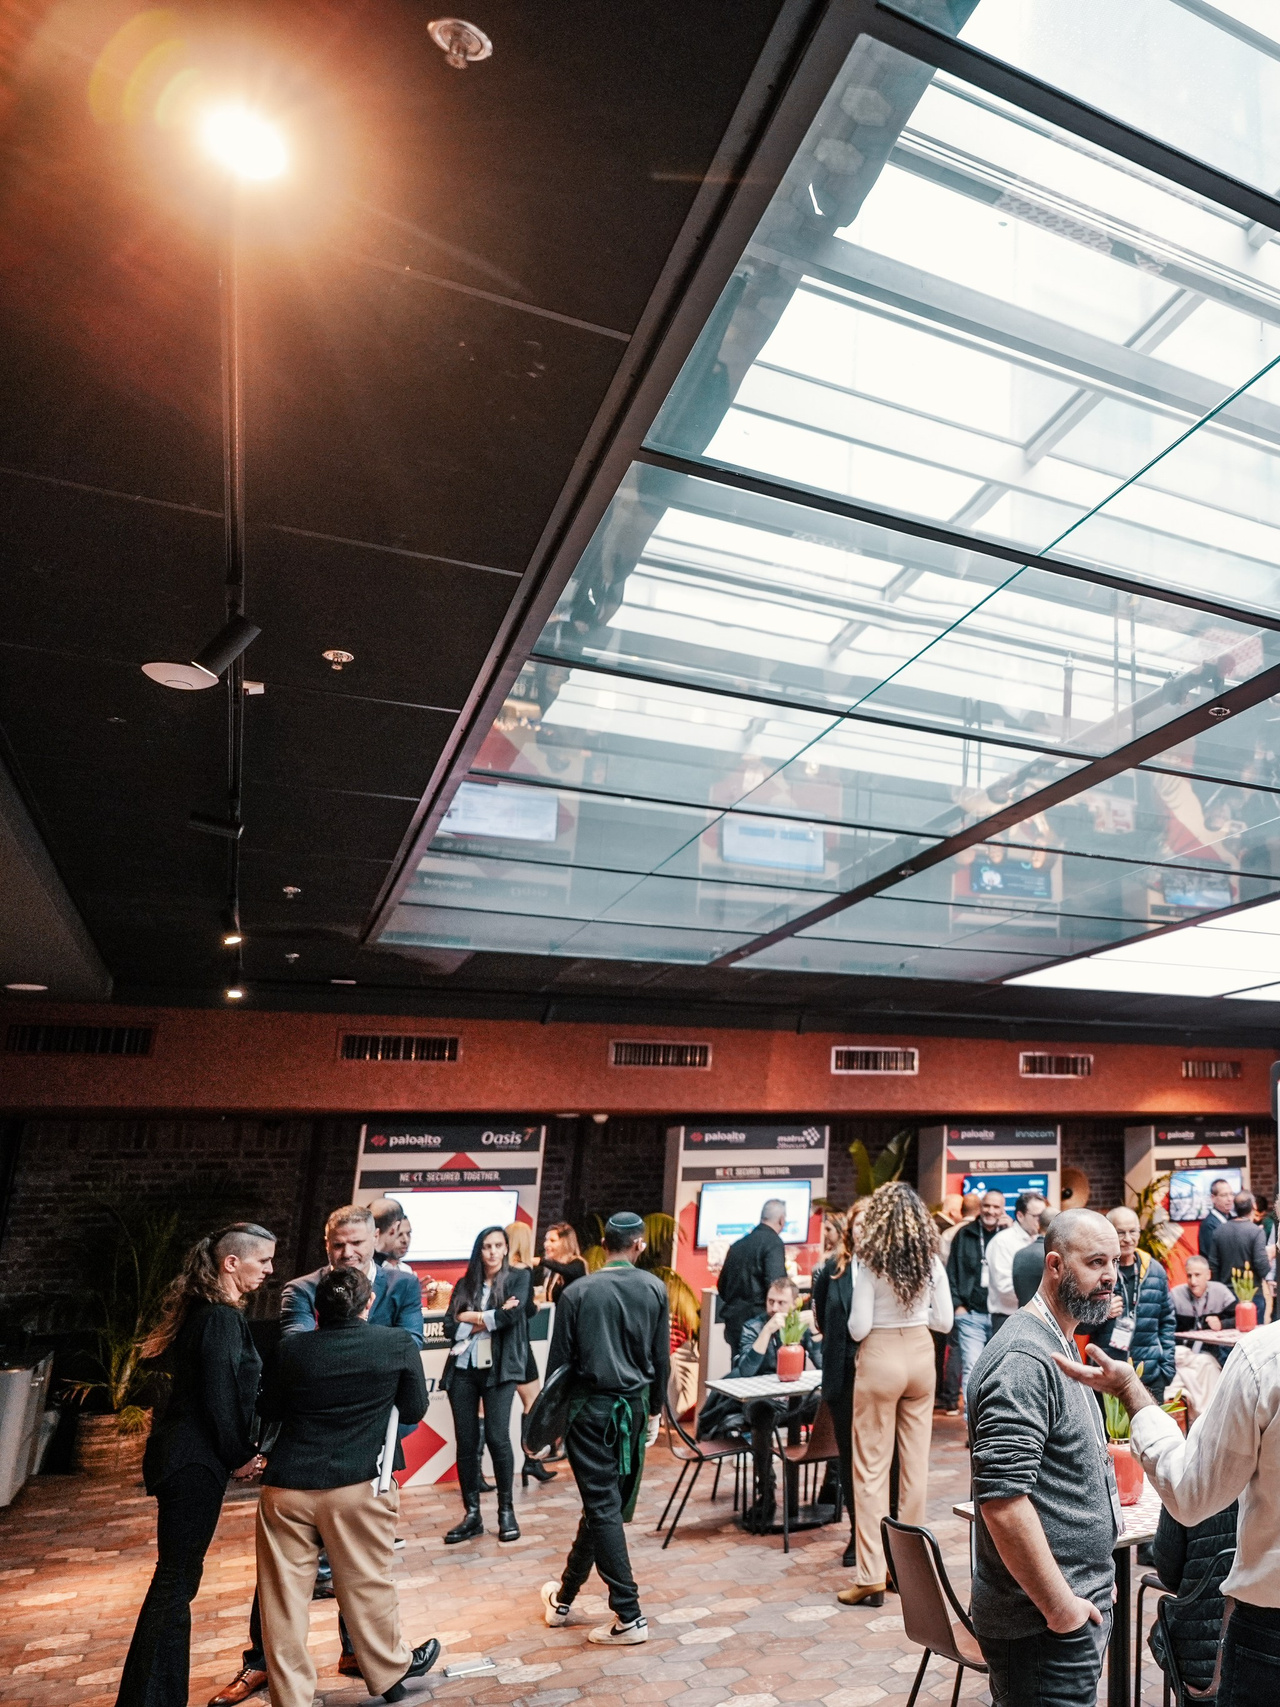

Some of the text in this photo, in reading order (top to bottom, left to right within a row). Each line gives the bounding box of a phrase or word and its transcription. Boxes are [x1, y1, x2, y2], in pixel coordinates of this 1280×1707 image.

[389, 1133, 442, 1147] paloalto
[481, 1131, 522, 1145] Oasis
[704, 1131, 746, 1143] paloalto
